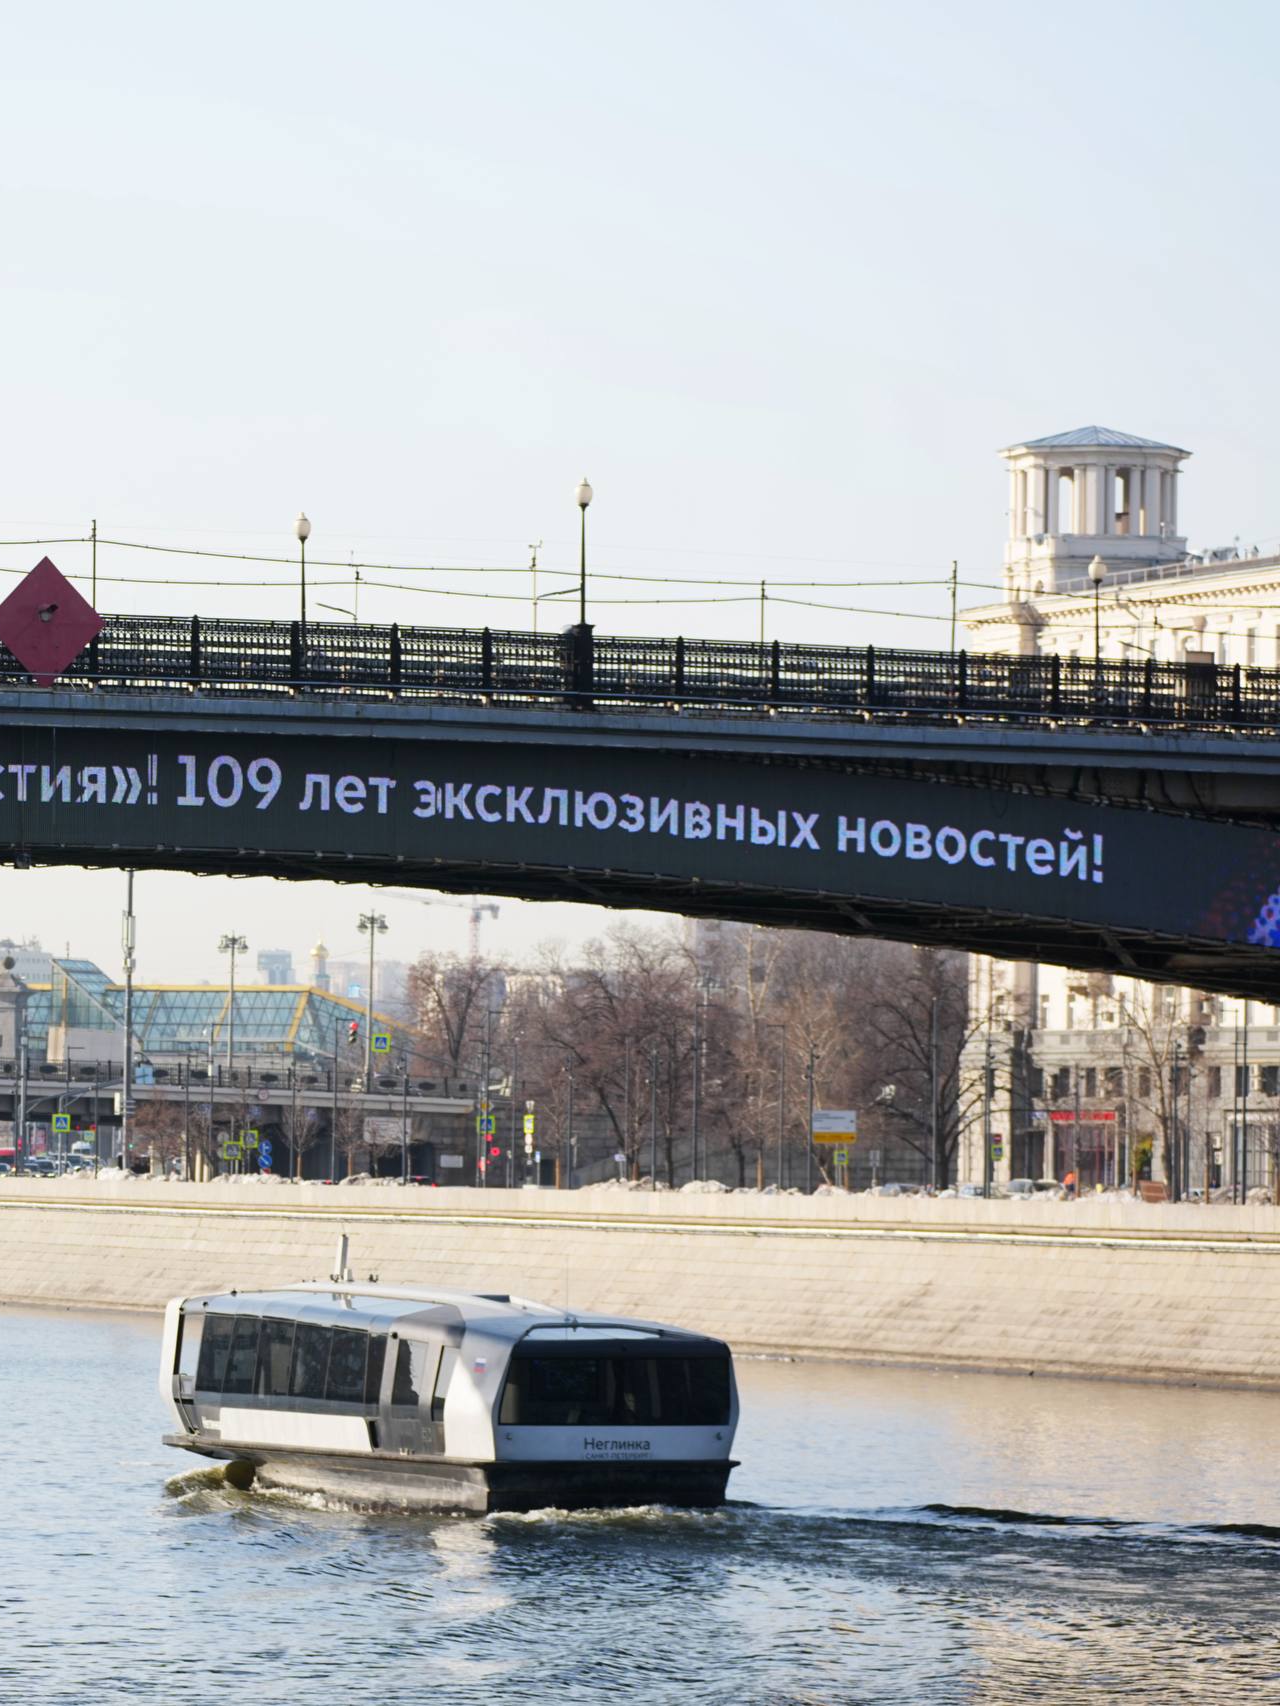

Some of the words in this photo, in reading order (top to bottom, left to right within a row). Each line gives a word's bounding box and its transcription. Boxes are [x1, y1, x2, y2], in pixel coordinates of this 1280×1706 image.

[176, 755, 283, 811] 109
[298, 773, 398, 815] лет
[413, 780, 821, 851] эксклюзивных
[836, 815, 1106, 884] новостей!
[583, 1438, 651, 1451] Неглинка
